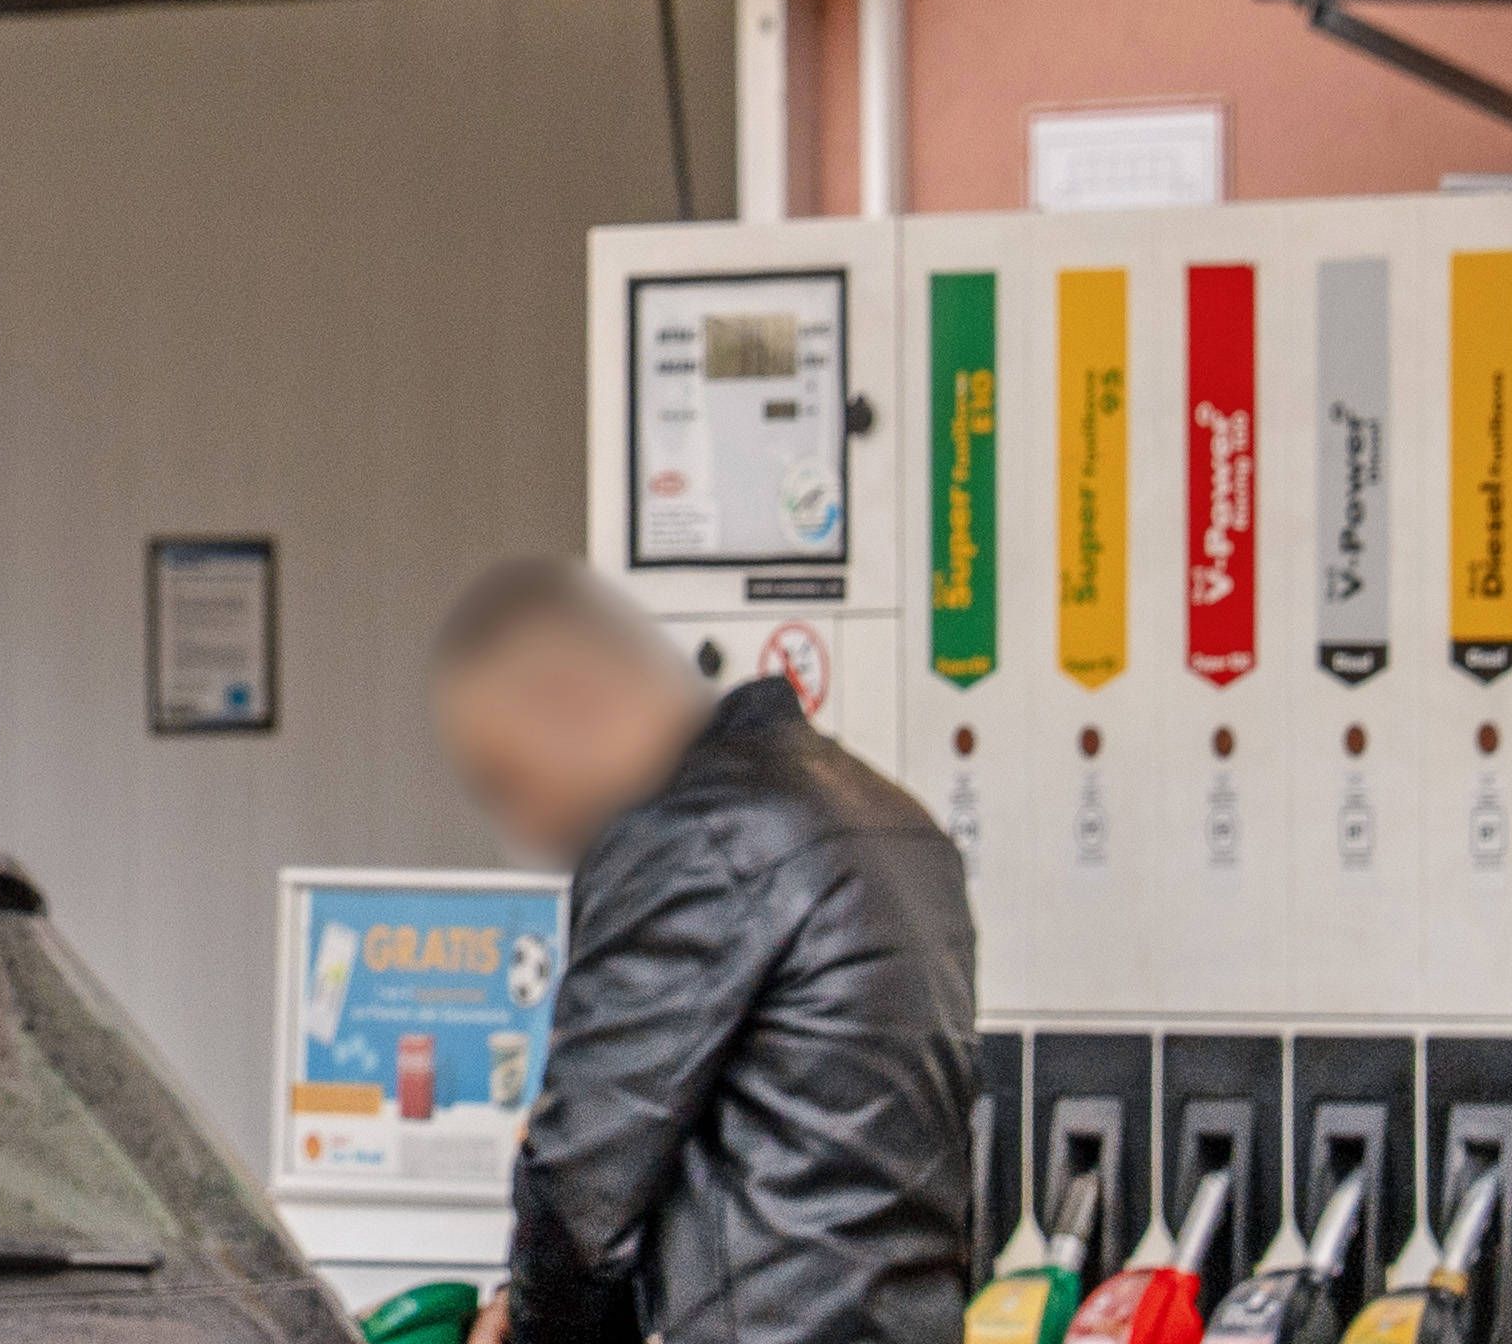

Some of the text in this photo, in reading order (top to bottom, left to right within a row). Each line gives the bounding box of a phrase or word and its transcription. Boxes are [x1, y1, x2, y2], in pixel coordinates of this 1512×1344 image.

[1339, 413, 1364, 600] V-Power
[1478, 481, 1504, 598] Diesel
[362, 923, 504, 975] GRATIS
